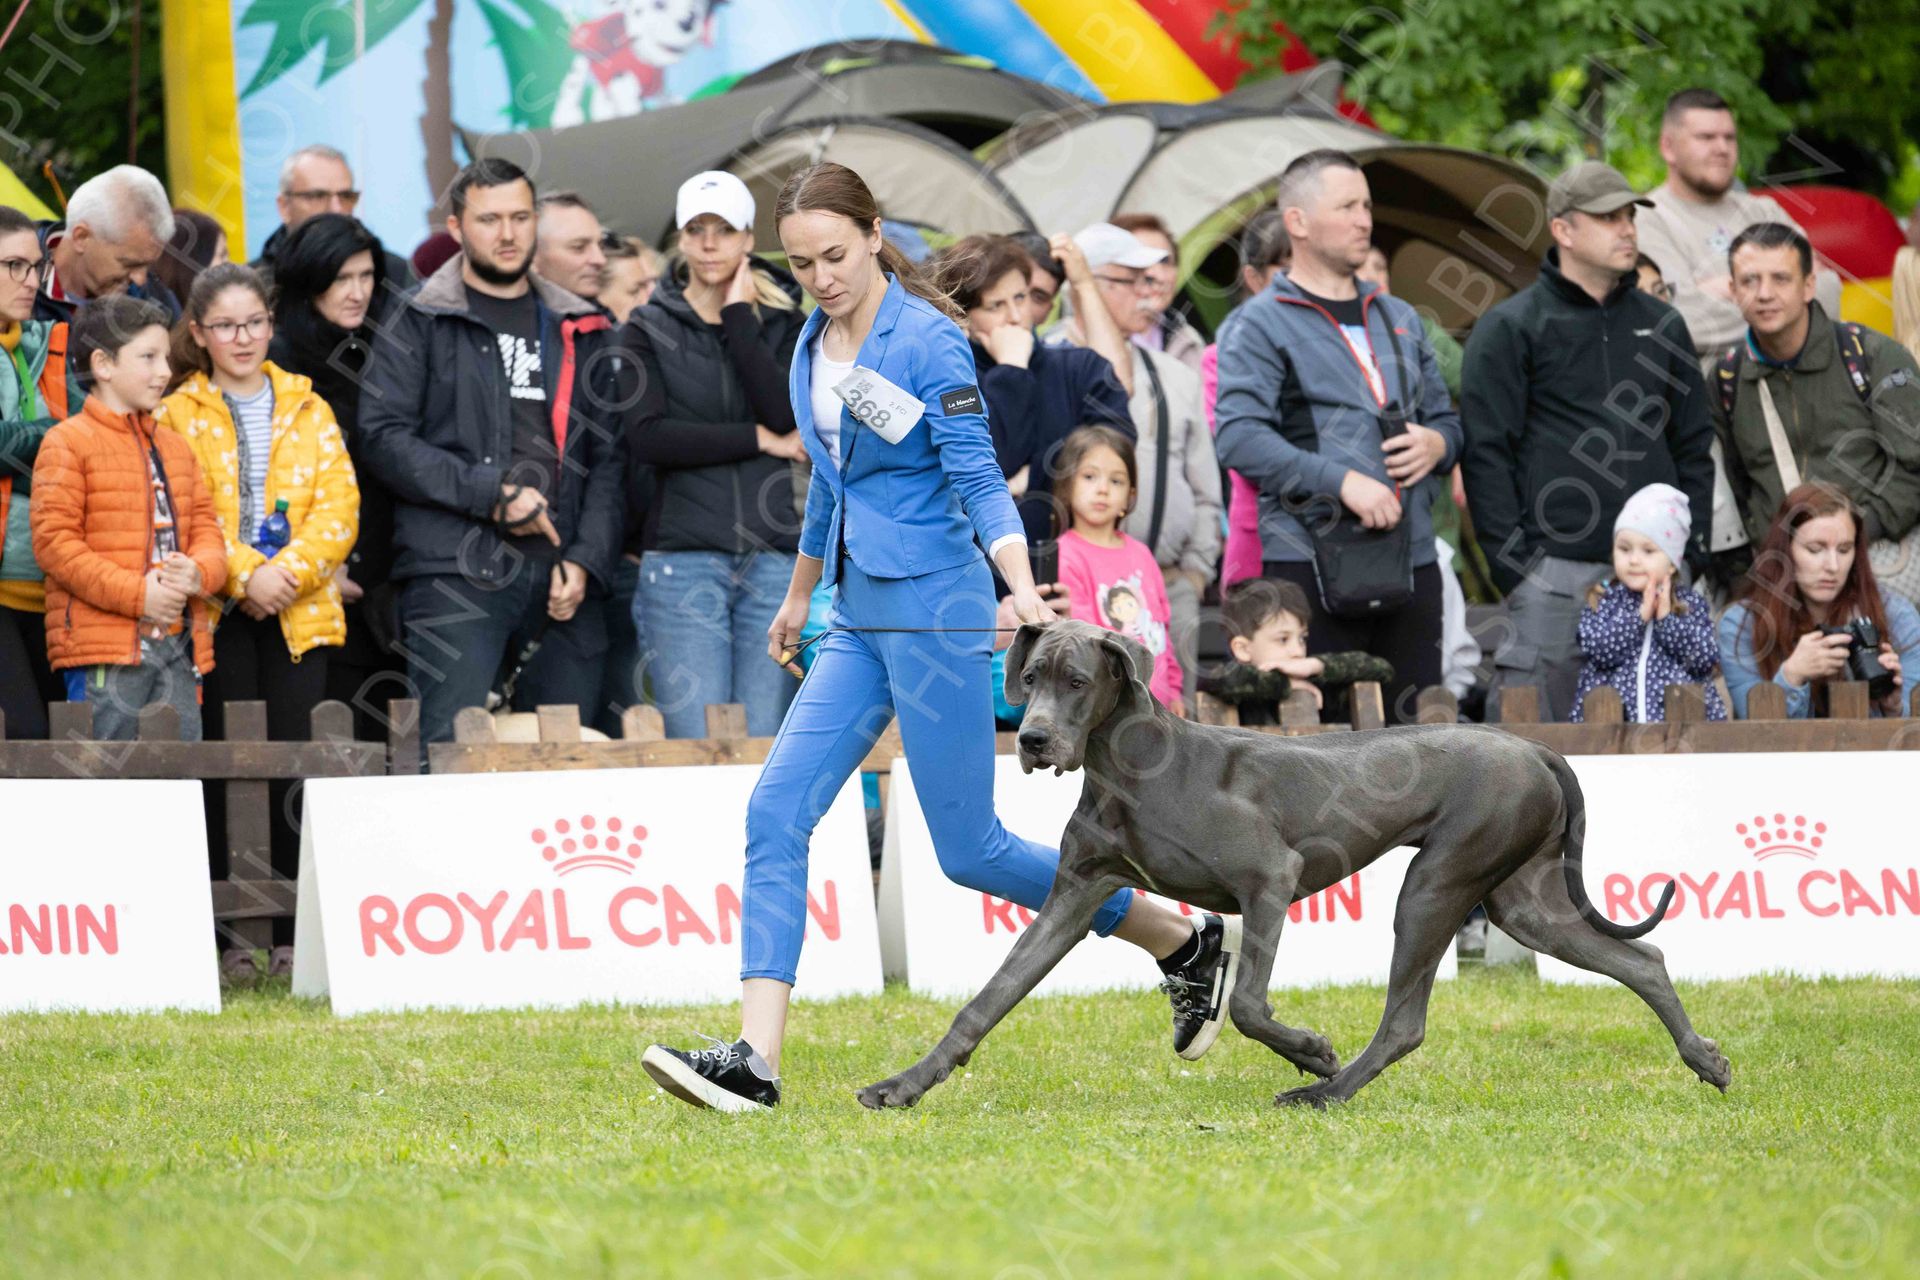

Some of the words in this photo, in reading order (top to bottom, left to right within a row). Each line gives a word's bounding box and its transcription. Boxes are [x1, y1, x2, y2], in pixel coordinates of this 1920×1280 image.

[849, 388, 891, 429] 368
[359, 887, 592, 957] ROYAL
[608, 879, 841, 948] CANN
[1603, 870, 1785, 922] ROYAL
[1798, 868, 1920, 917] CAN
[0, 903, 119, 955] NIN
